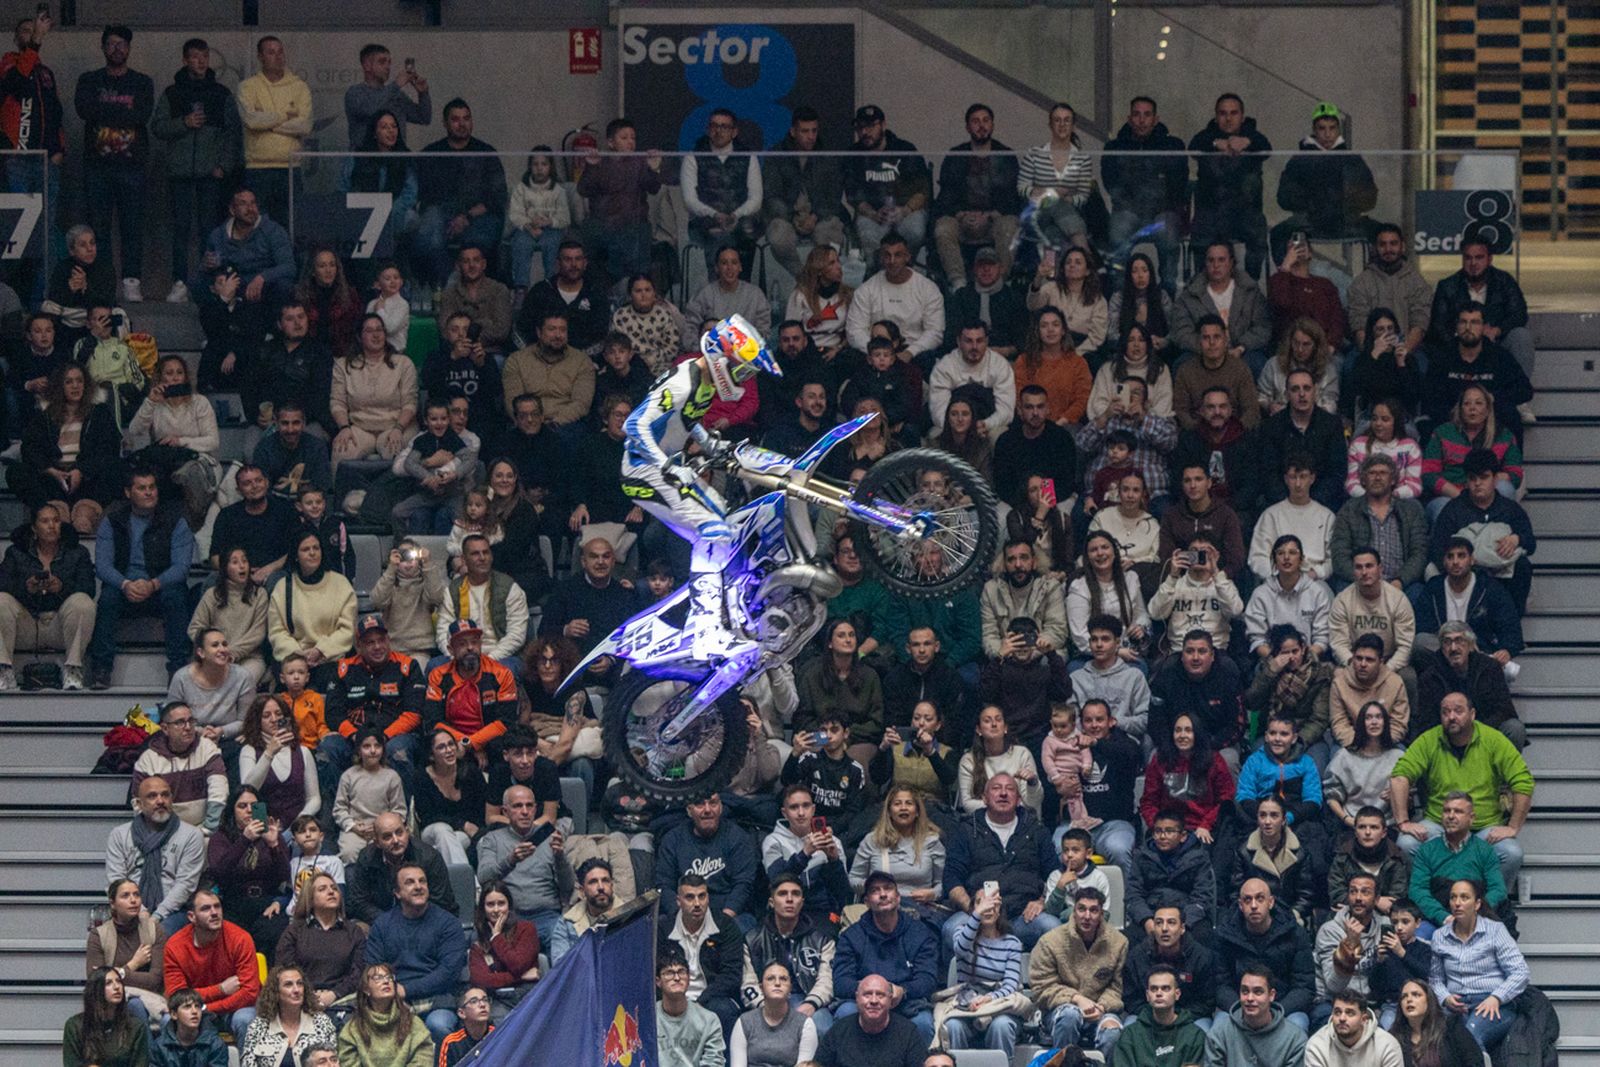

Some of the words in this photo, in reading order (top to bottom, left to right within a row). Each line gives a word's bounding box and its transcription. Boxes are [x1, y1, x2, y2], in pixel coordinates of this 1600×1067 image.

[623, 26, 770, 65] Sector
[17, 97, 33, 153] ACING
[865, 170, 896, 182] PUMA
[0, 193, 43, 259] 7
[346, 192, 393, 259] 7
[1462, 190, 1513, 254] 8
[1354, 615, 1388, 630] AM76
